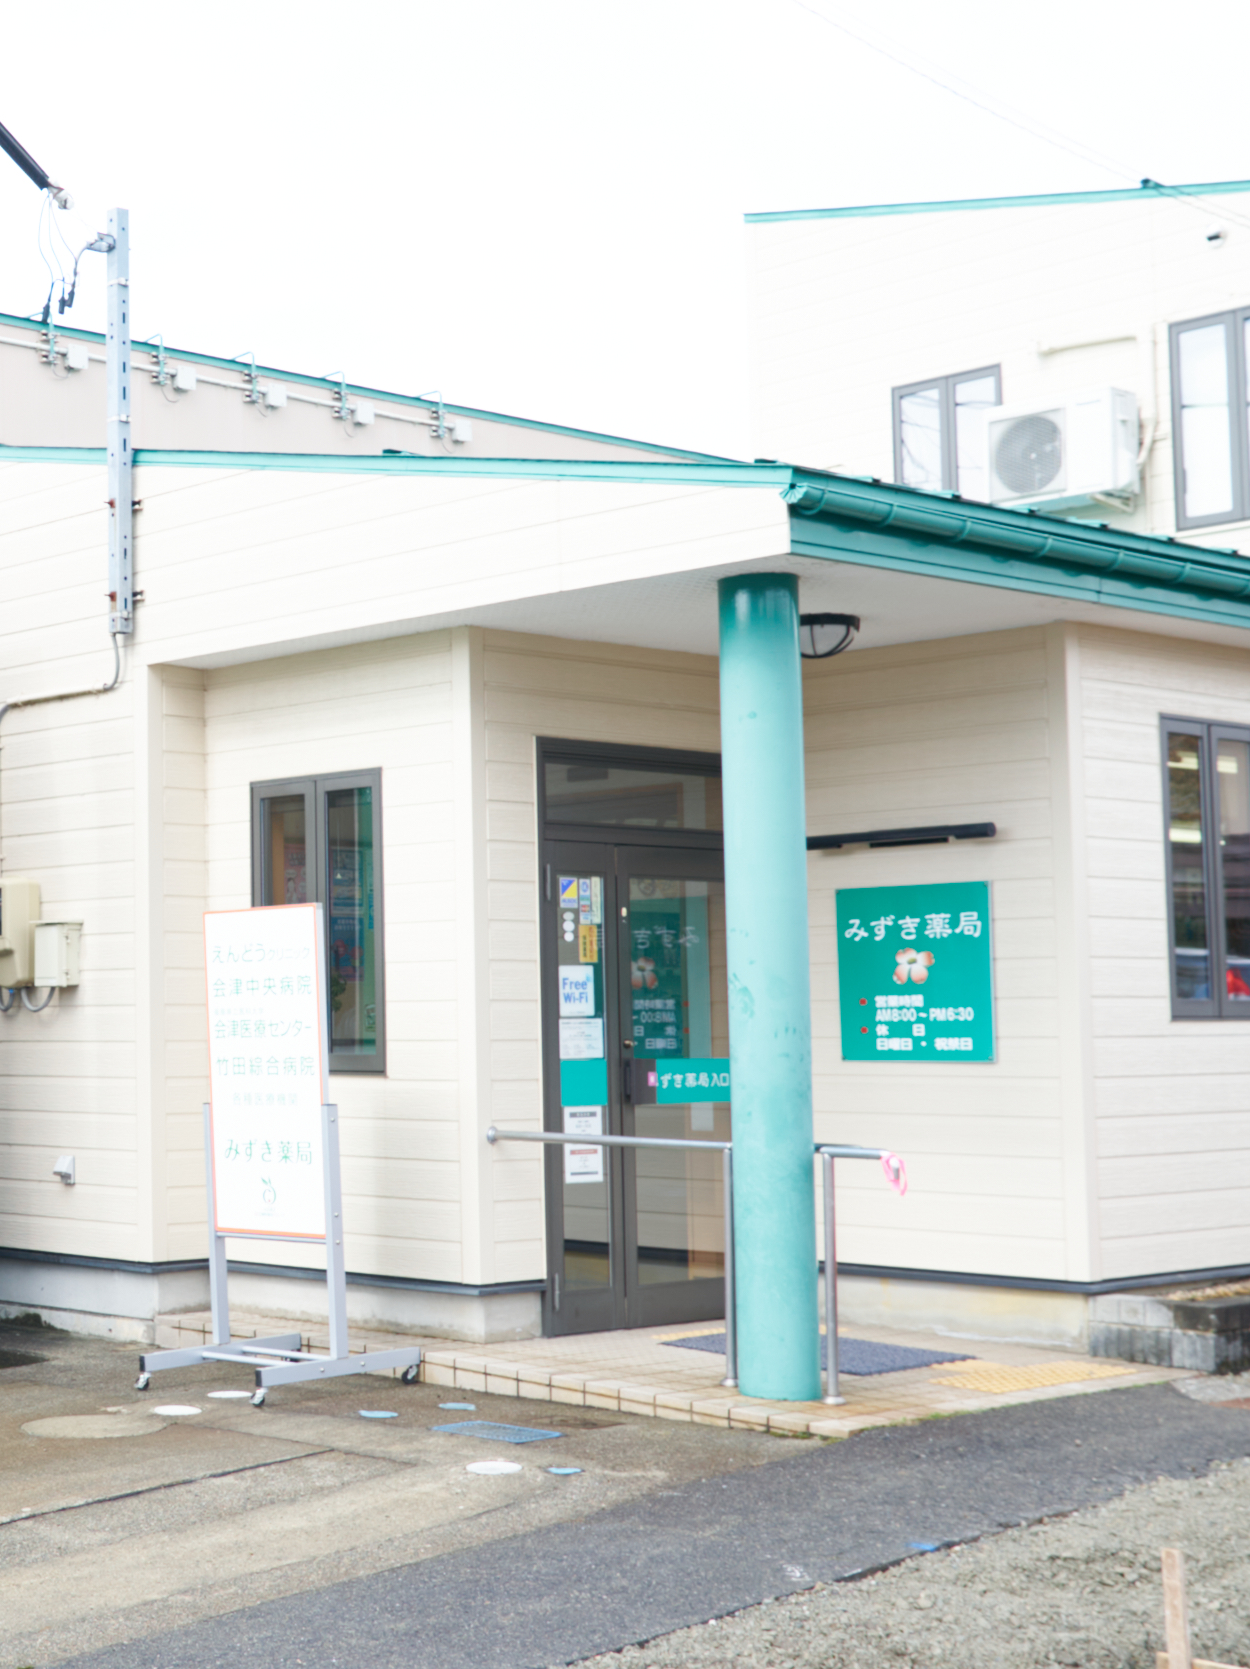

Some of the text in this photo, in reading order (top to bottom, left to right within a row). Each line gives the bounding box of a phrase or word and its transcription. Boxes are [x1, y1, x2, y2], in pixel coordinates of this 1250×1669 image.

[845, 911, 982, 941] みずき薬局
[212, 943, 310, 964] えんどうクリニック
[212, 975, 313, 998] 会津中央病院
[562, 977, 588, 990] Free
[563, 991, 589, 1004] Wi-Fi
[874, 994, 924, 1008] 営業時間
[214, 1018, 312, 1039] 会津医療センター
[216, 1055, 315, 1076] 竹田綜合病院
[655, 1072, 730, 1089] ずき薬局入口
[224, 1138, 312, 1165] みずき薬局
